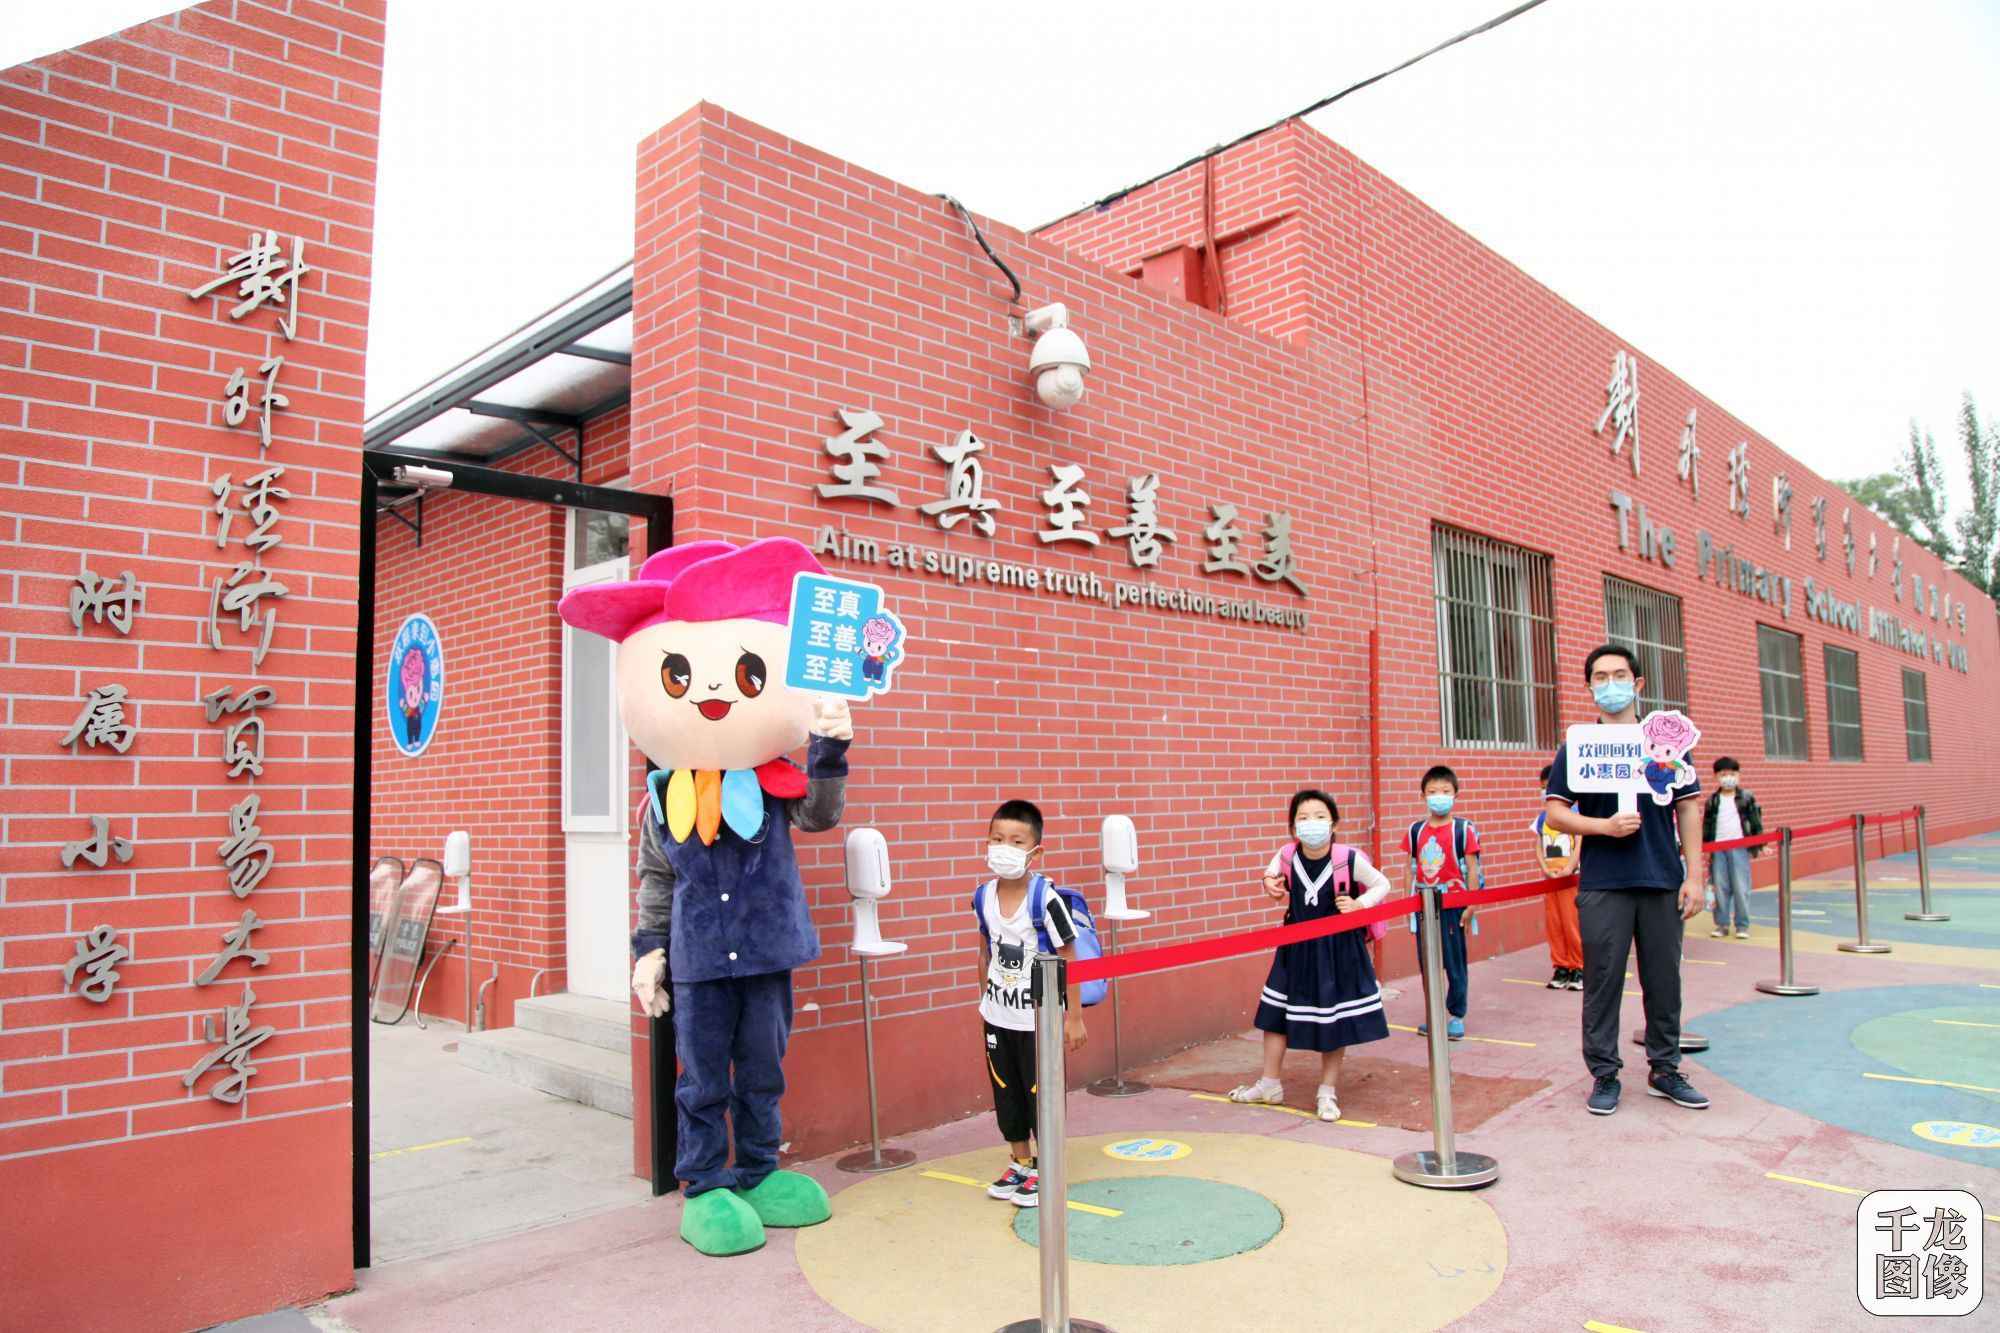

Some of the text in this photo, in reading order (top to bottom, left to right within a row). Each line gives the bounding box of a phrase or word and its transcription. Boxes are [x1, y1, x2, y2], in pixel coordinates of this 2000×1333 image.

[814, 524, 880, 563] Aim
[887, 542, 919, 570] at
[924, 546, 1040, 589] supreme
[1114, 581, 1216, 615] perfection
[1218, 599, 1252, 622] and
[1255, 600, 1309, 633] beauty
[1608, 488, 1677, 569] The
[1695, 528, 1792, 619] Primary
[1803, 574, 1862, 636] School
[811, 586, 861, 620] 至真
[807, 620, 857, 653] 至善
[802, 654, 853, 687] 至美
[1578, 743, 1642, 758] 欢迎回到
[60, 569, 145, 1004] 附属小学
